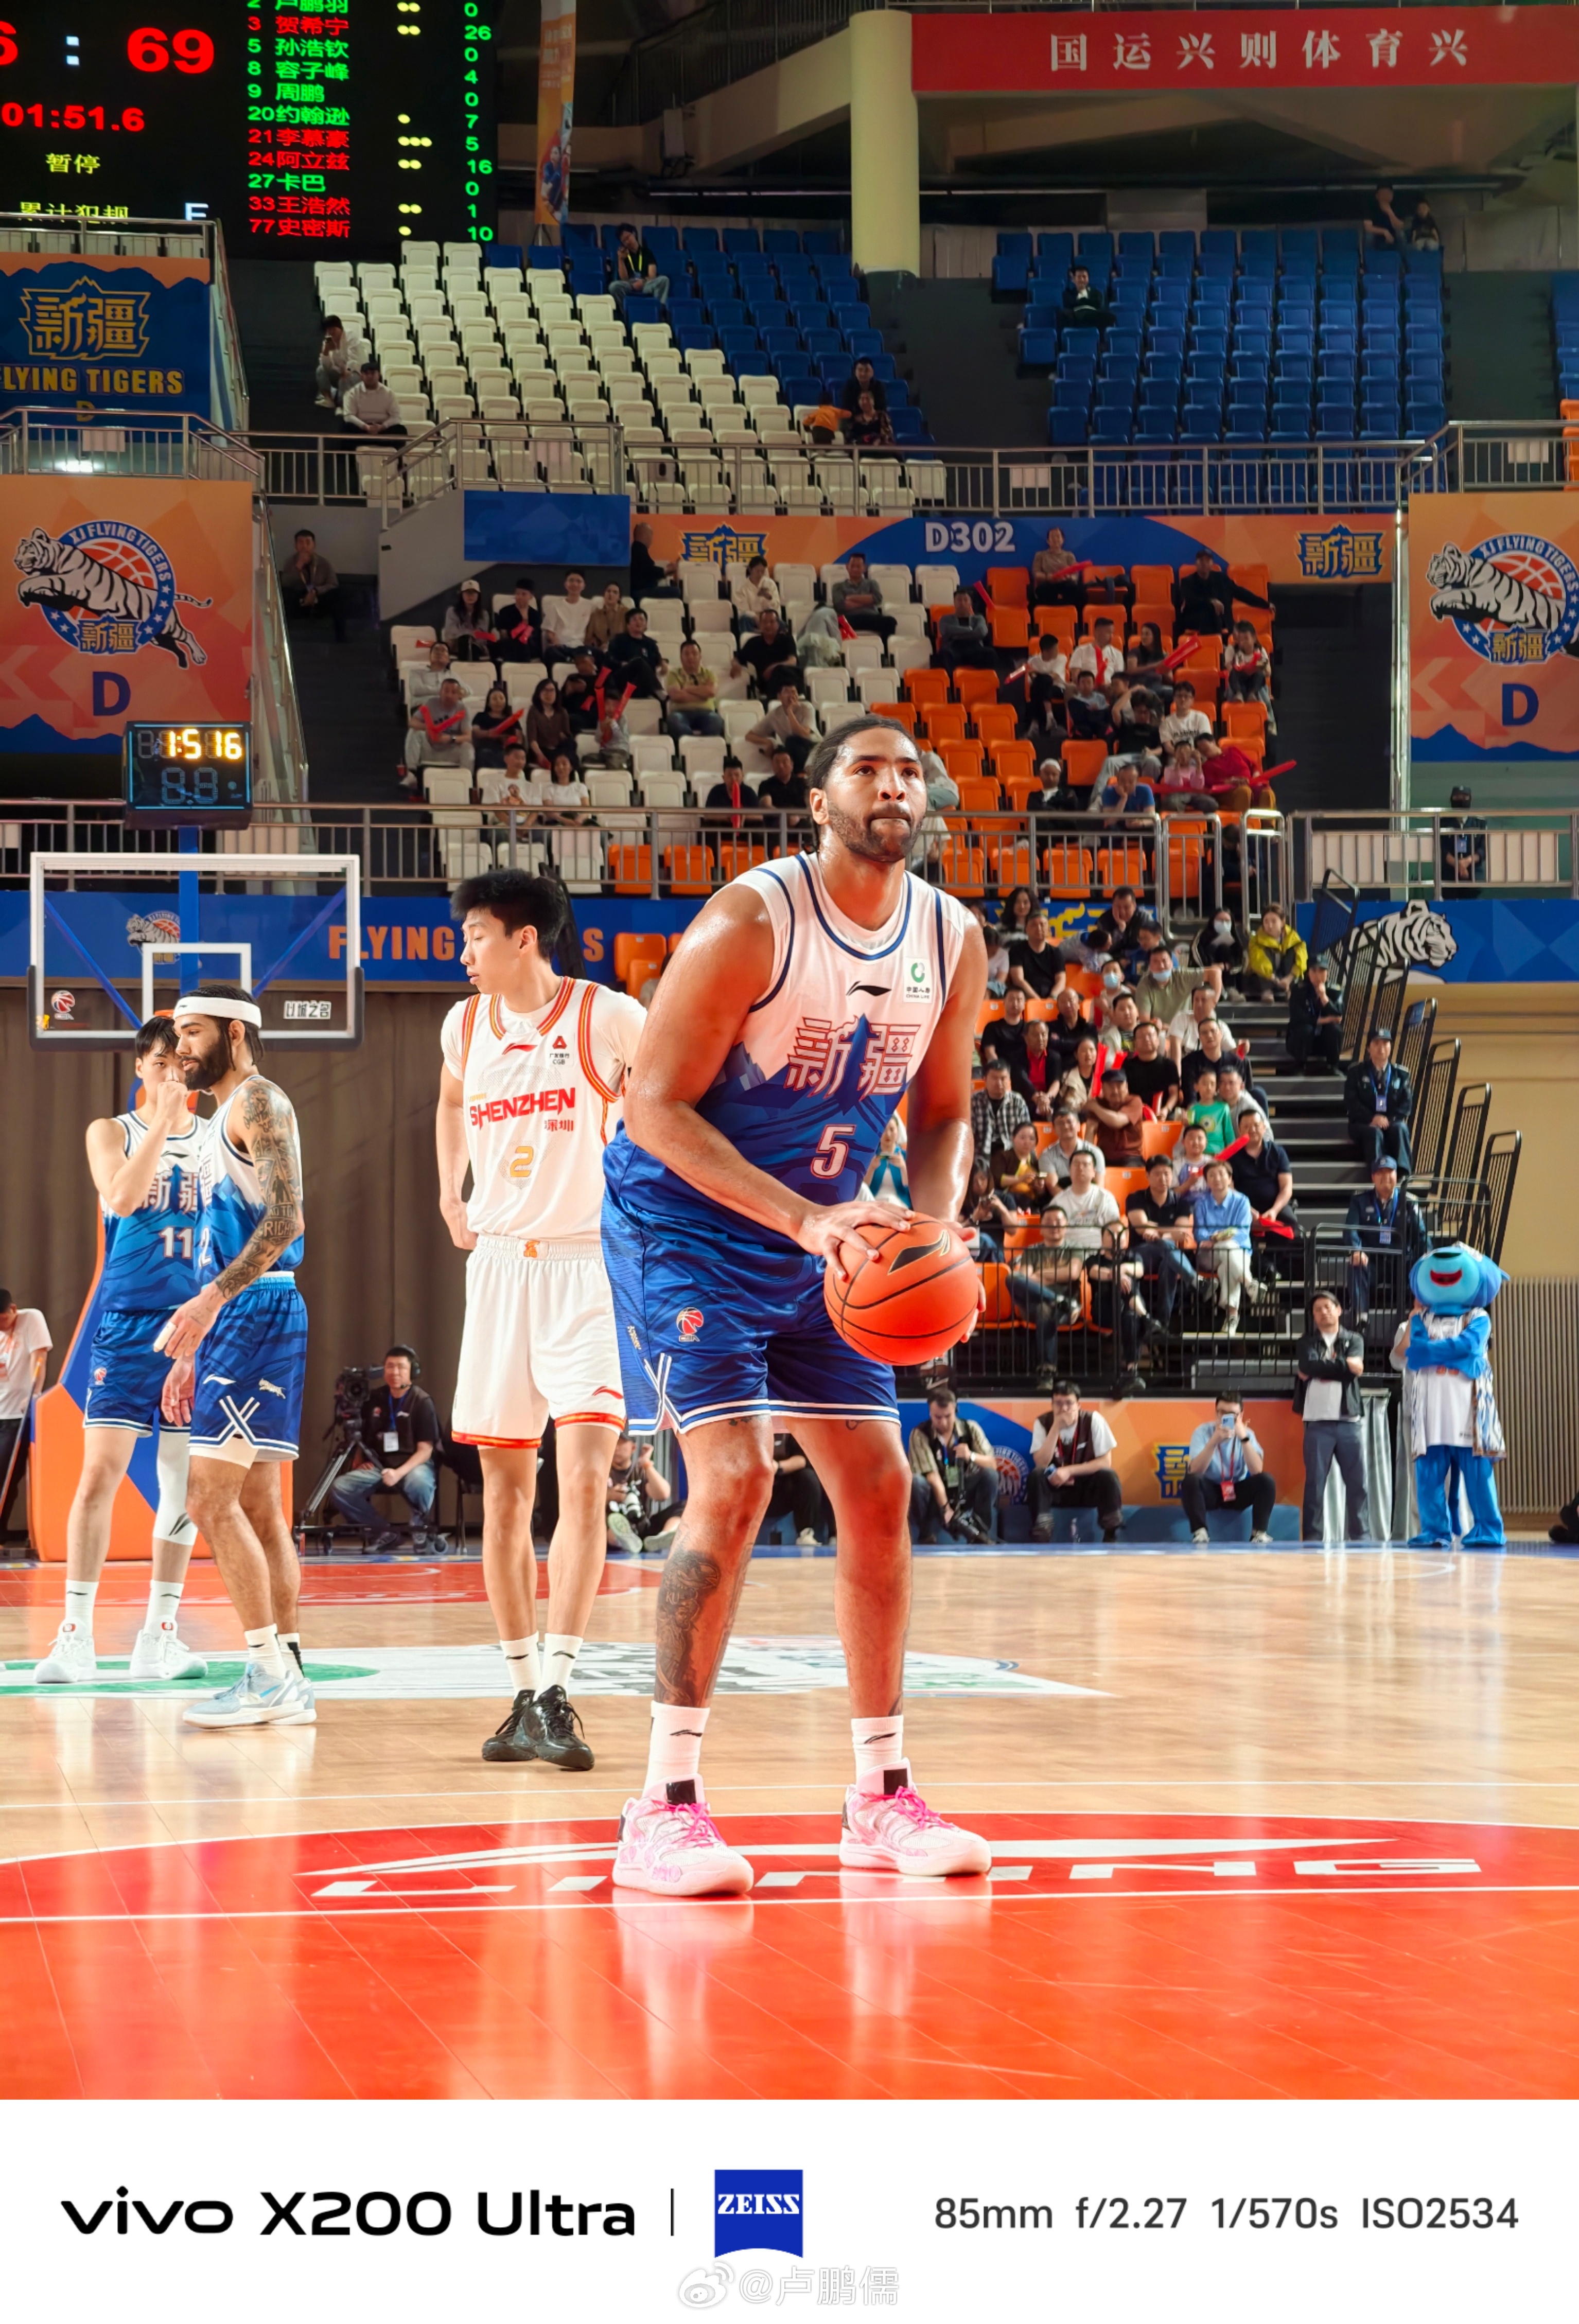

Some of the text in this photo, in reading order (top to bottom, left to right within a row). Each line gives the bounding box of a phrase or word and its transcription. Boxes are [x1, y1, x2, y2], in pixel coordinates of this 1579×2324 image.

[248, 15, 491, 40] 3 贺希宁 26
[127, 27, 214, 74] 69
[248, 38, 478, 62] 5 孙浩钦 0
[1051, 29, 1469, 71] 国运兴则体育兴
[248, 60, 478, 84] 8 容子峰 4
[248, 83, 478, 107] 9 周鹏 0
[2, 102, 144, 132] 01:51.6
[276, 105, 350, 126] 约翰逊
[466, 114, 478, 129] 7
[466, 136, 479, 151] 5
[46, 153, 100, 174] 暂停
[467, 160, 492, 174] 16
[276, 172, 326, 192] 卡巴
[465, 182, 479, 196] 0
[277, 197, 350, 215] 王浩然
[468, 204, 476, 218] 1
[277, 218, 350, 238] 史密斯
[468, 226, 493, 241] 10
[33, 292, 137, 353] 新疆
[0, 366, 183, 394] LYING TIGERS
[76, 400, 95, 422] D
[69, 522, 172, 582] XJ FLYING TIGERS
[925, 521, 1016, 553] D302
[1304, 534, 1378, 576] 新疆
[1480, 534, 1579, 592] XJ FLYING TIGERS
[81, 621, 135, 652] 新疆
[1492, 630, 1545, 662] 新疆
[93, 671, 131, 716] D
[1502, 683, 1539, 727] D
[329, 926, 454, 961] FYING
[783, 1015, 921, 1101] 新疆
[469, 1087, 576, 1131] SHENZHEN
[544, 1119, 574, 1132] 深圳
[510, 1146, 534, 1177] 2
[811, 1123, 856, 1179] 5
[159, 1225, 194, 1259] 11
